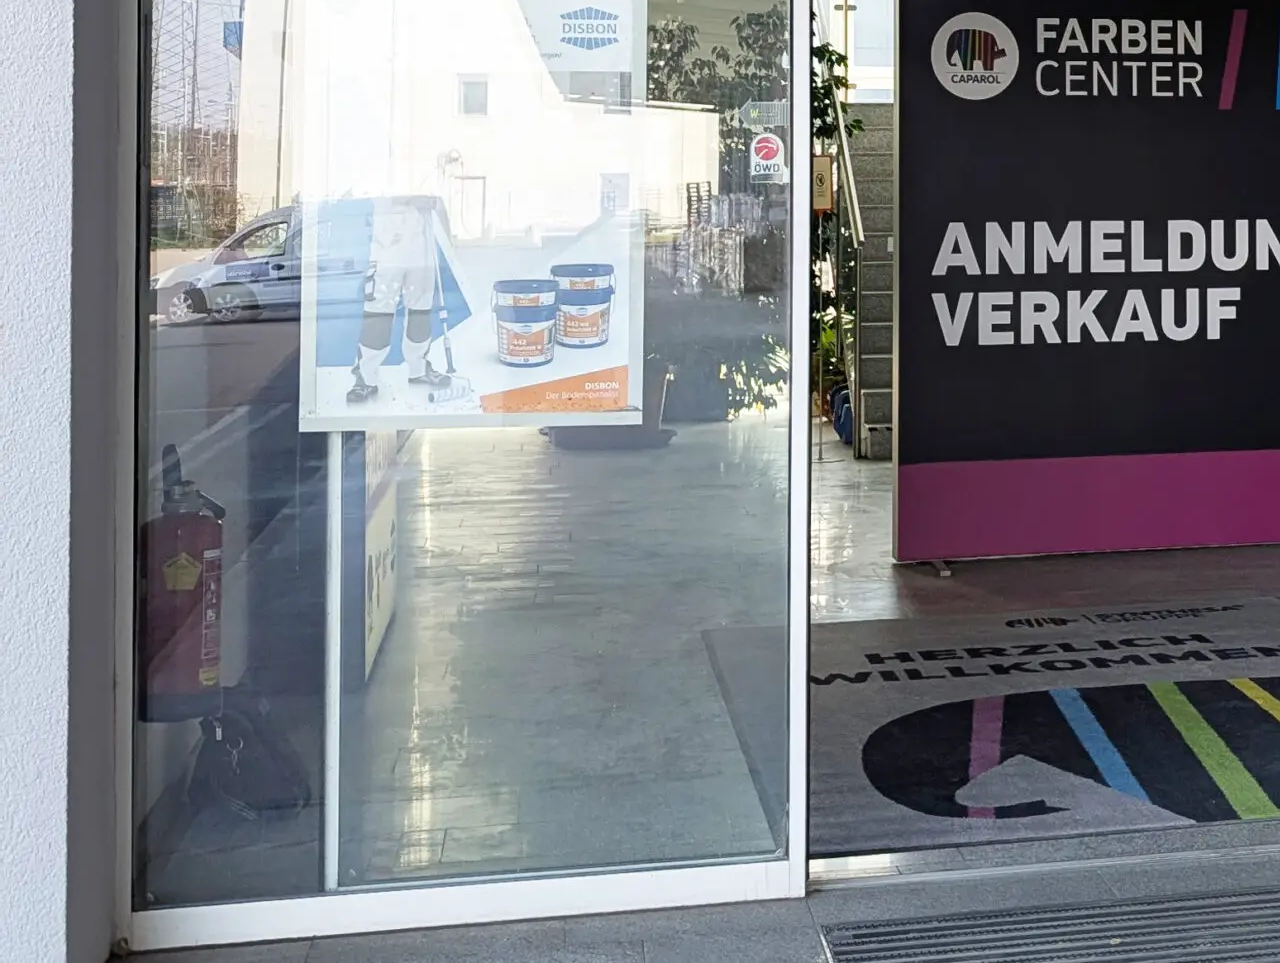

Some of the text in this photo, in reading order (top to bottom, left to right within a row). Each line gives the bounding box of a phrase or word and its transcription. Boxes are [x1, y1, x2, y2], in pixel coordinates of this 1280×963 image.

[562, 22, 618, 34] DISBON
[1036, 18, 1204, 55] FARBEN
[951, 74, 1001, 85] CAPAROL
[1035, 60, 1204, 98] CENTER
[754, 161, 780, 173] ÖWD
[931, 287, 1241, 346] VERKAUF
[585, 381, 620, 390] DISBON
[864, 633, 1215, 665] HERZLICH
